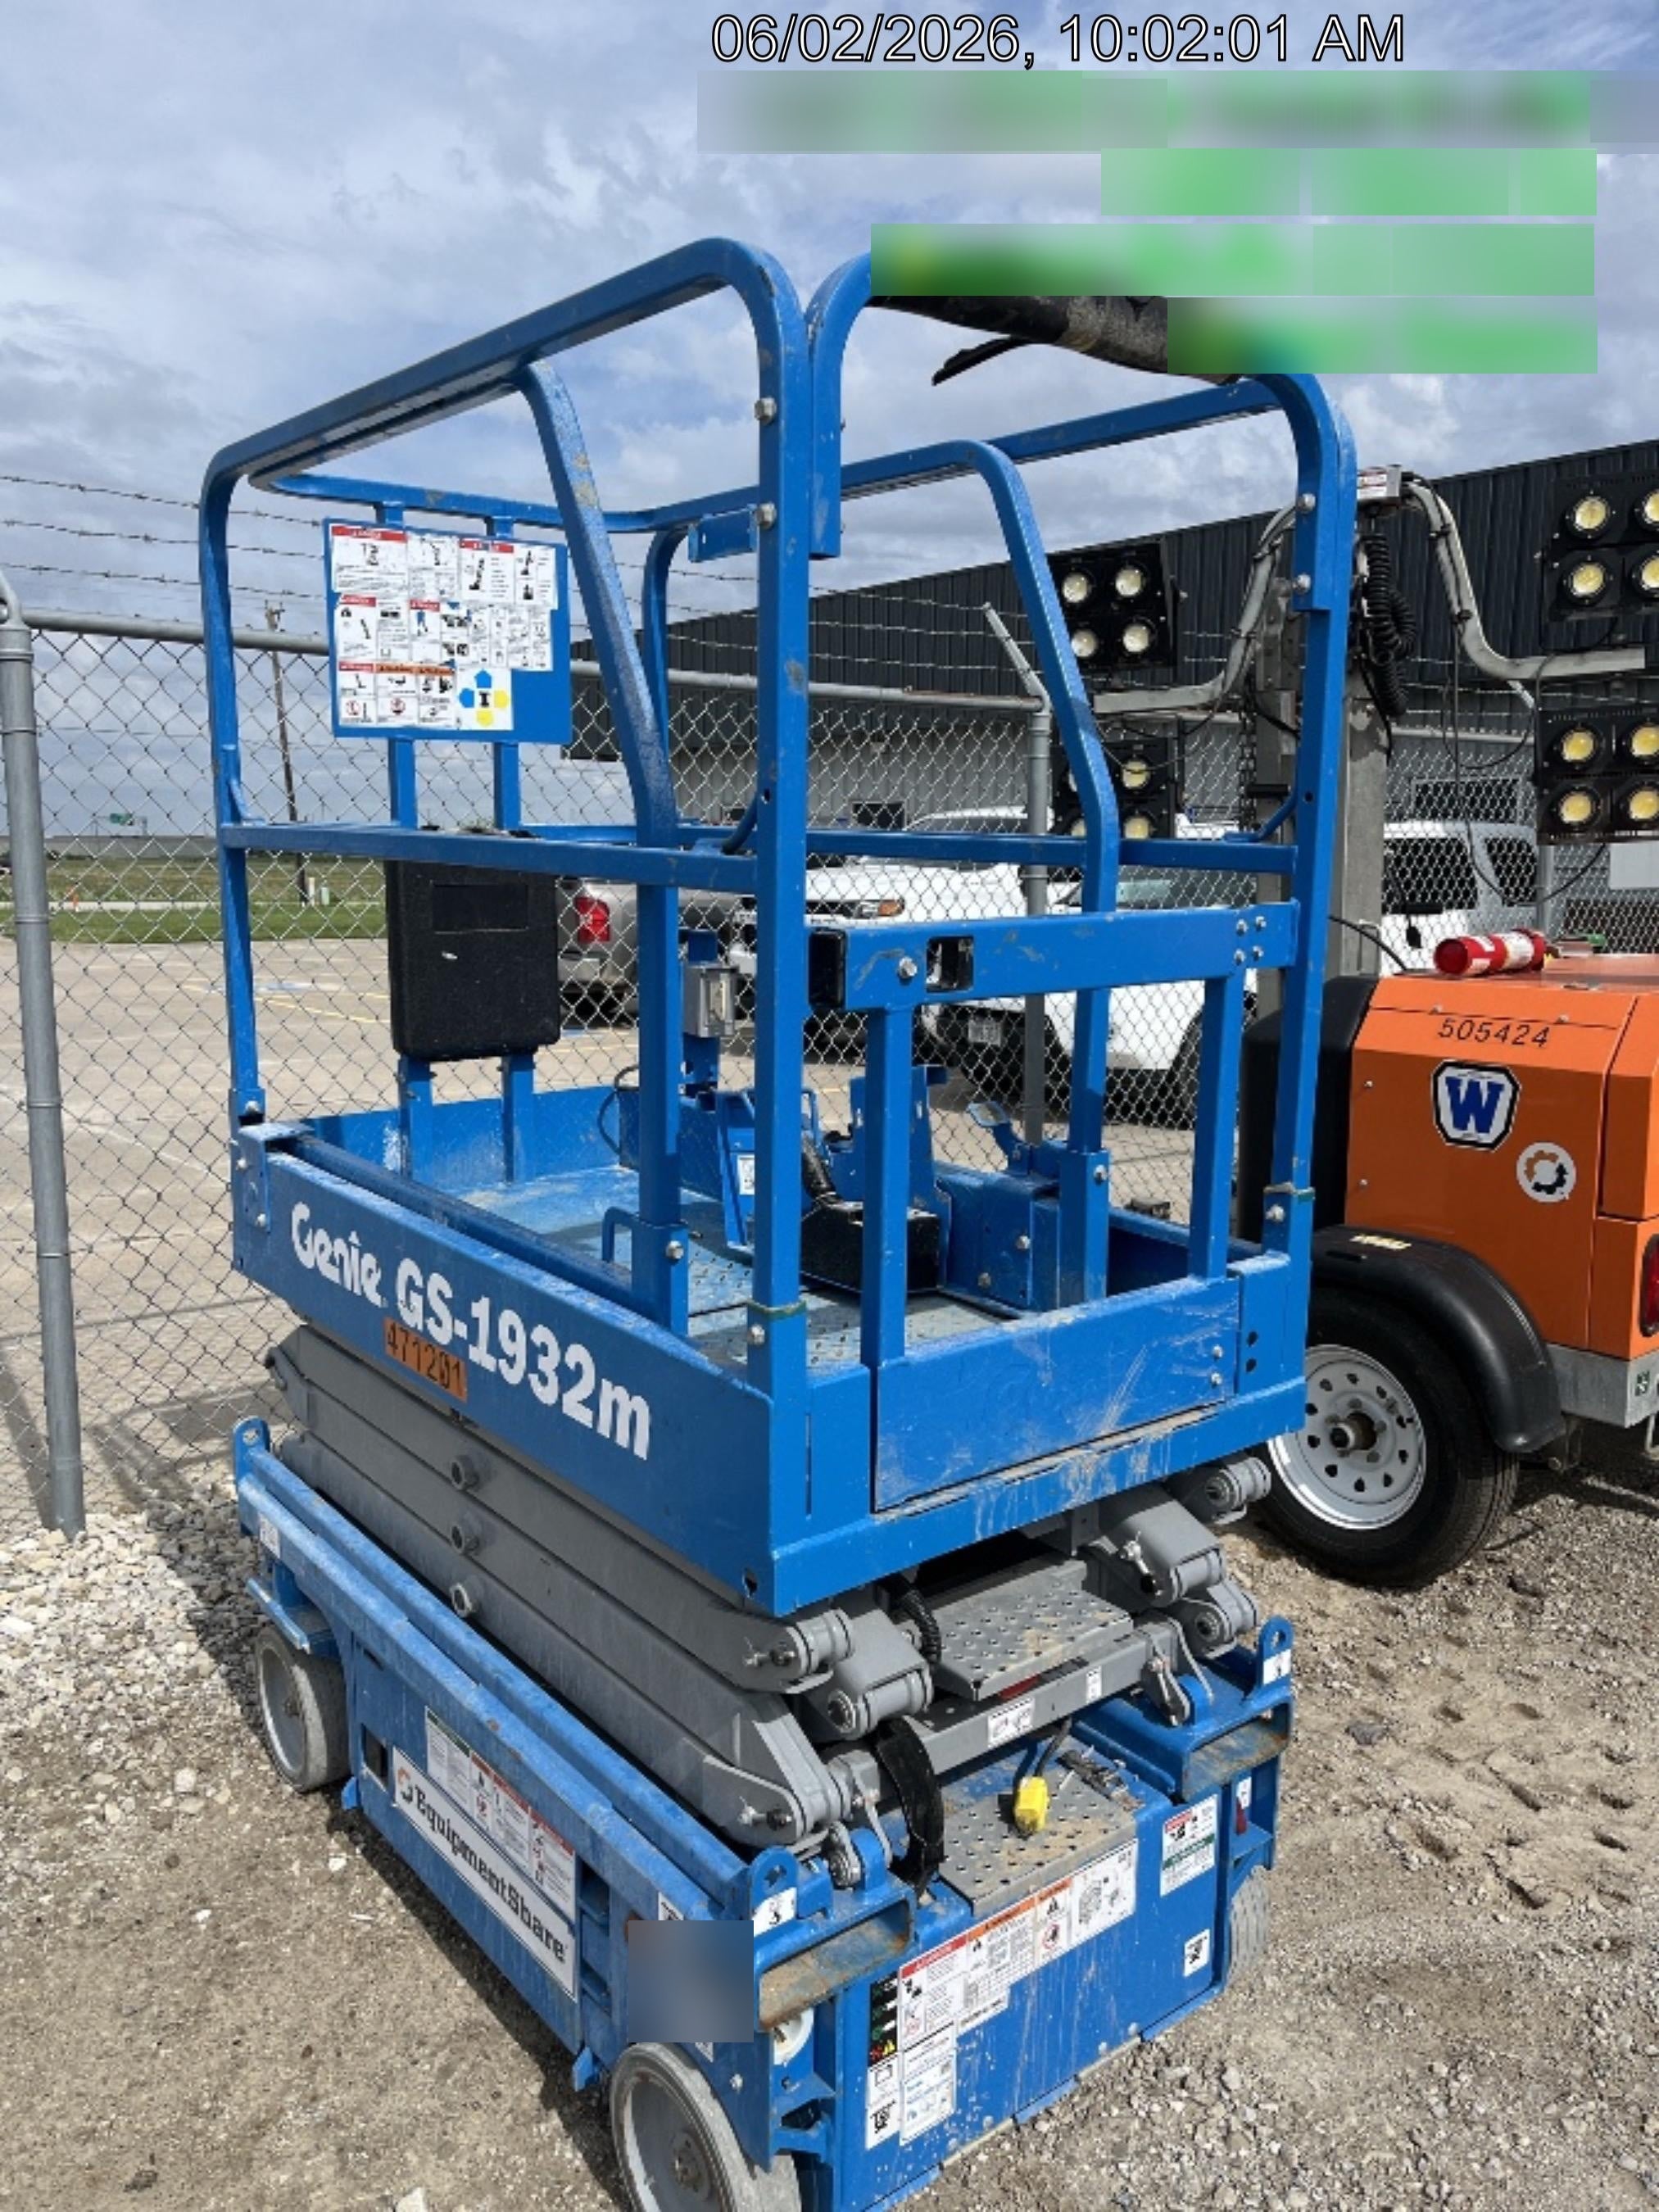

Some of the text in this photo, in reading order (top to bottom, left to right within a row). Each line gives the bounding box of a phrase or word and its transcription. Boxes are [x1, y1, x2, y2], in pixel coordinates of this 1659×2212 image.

[1438, 1018, 1550, 1048] 505424
[1444, 1077, 1506, 1134] W
[292, 1201, 650, 1460] Genie GS-1932m
[387, 1321, 464, 1398] 471201
[415, 1785, 565, 1963] EquipmentShare
